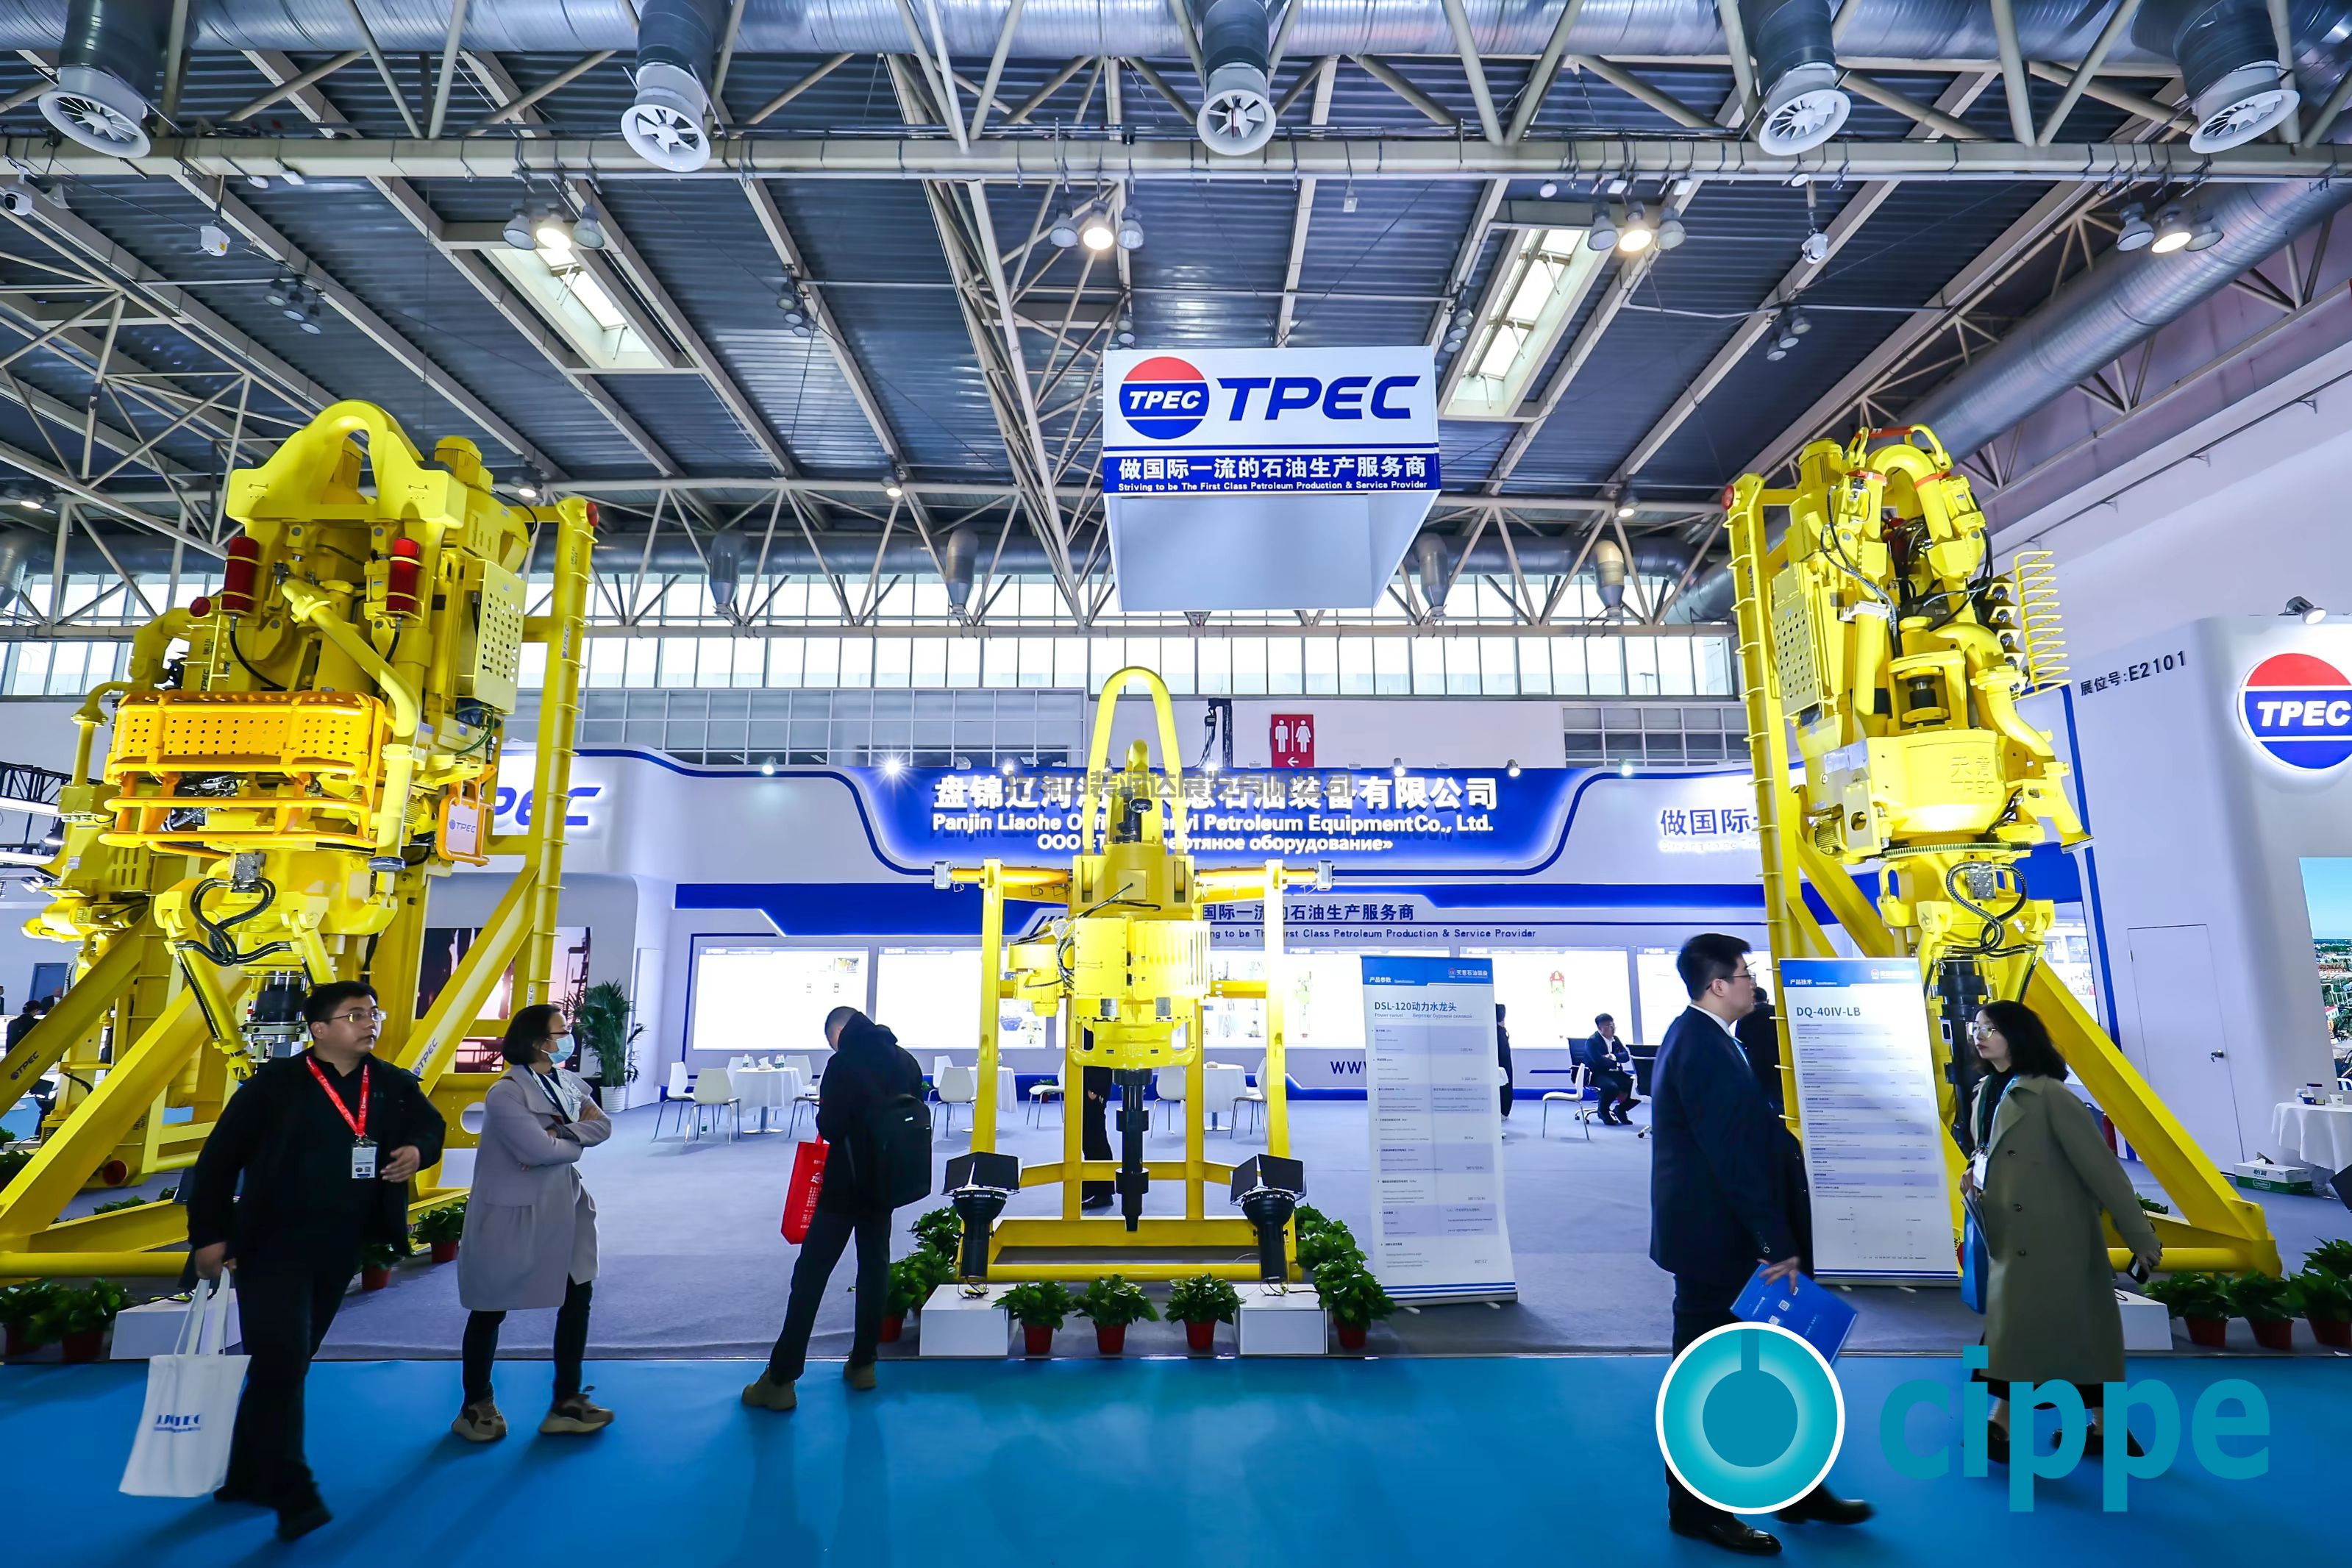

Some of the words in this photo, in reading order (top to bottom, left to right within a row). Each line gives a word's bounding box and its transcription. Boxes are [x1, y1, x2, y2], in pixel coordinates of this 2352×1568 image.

[1129, 389, 1202, 410] TPEC
[1216, 375, 1422, 421] TPEC
[1119, 456, 1426, 480] 做国际一流的石油生产服务商
[1119, 482, 1153, 492] Striving
[1168, 482, 1178, 491] be
[1181, 482, 1197, 491] The
[1200, 482, 1221, 491] First
[1223, 481, 1247, 491] Class
[1250, 481, 1294, 490] Petroleum
[1296, 481, 1342, 490] Production
[1345, 481, 1353, 489] &
[1355, 480, 1389, 489] Service
[1391, 480, 1428, 489] Provider
[2080, 651, 2187, 696] 展位号:E2101
[2257, 700, 2352, 727] TPEC
[494, 786, 602, 826] PEC
[456, 822, 476, 833] TPEC
[933, 813, 991, 833] Panjin
[998, 813, 1060, 831] Liaohe
[1204, 813, 1303, 832] Petroleum
[1457, 814, 1494, 832] Ltd.
[1037, 833, 1081, 850] ООО
[1249, 834, 1394, 854] оборудование»
[1225, 929, 1235, 938] to
[1239, 929, 1250, 938] be
[1302, 929, 1330, 938] Class
[1333, 929, 1383, 938] Petroleum
[1386, 929, 1439, 938] Production
[1442, 928, 1450, 938] &
[1454, 928, 1491, 938] Service
[1494, 928, 1536, 938] Provider
[1375, 1002, 1457, 1012] DSL-120动力水龙头
[1797, 1007, 1861, 1018] DQ-40IV-LB
[16, 1050, 40, 1074] TPEC
[418, 1038, 438, 1068] TPEC
